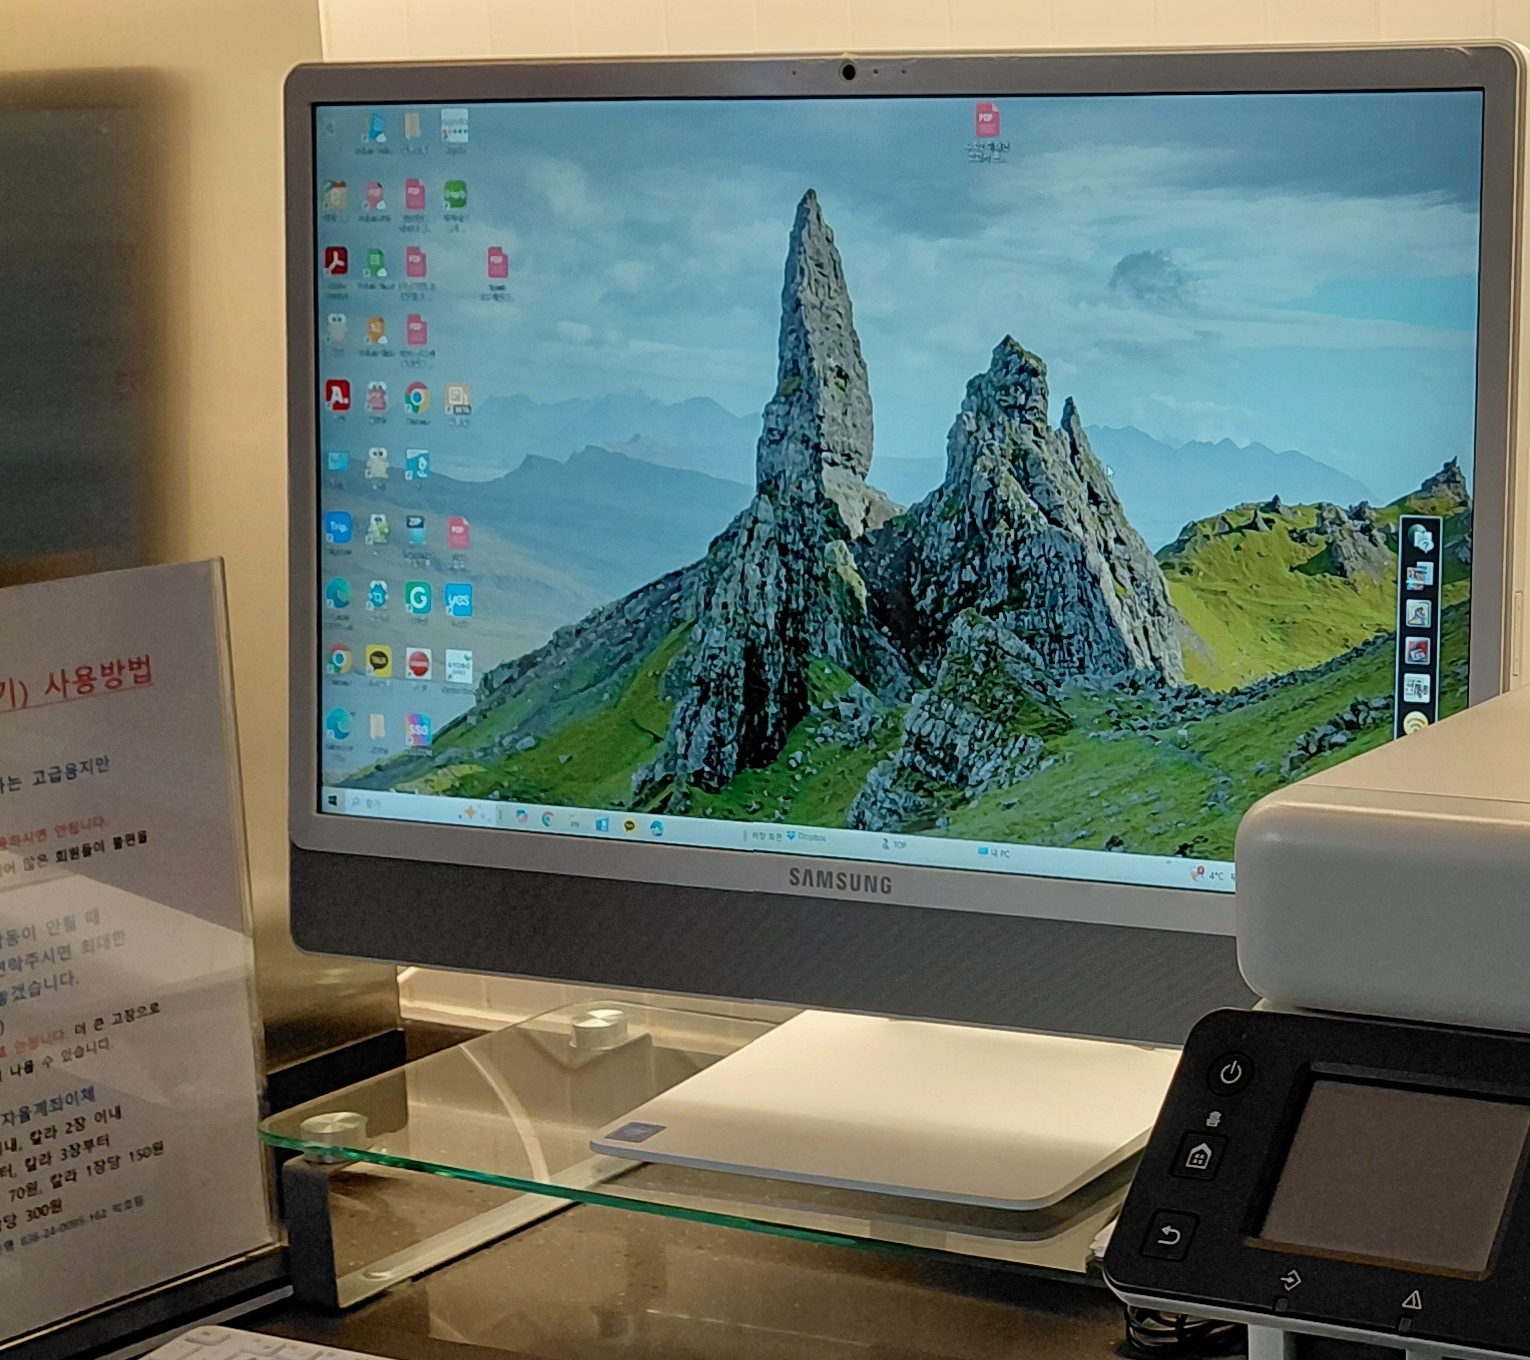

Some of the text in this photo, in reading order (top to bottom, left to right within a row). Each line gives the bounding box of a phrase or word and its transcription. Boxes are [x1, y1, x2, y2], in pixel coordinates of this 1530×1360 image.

[44, 654, 153, 699] 사용방법
[31, 755, 110, 786] 고급용지만
[789, 867, 892, 894] SAMSUNG
